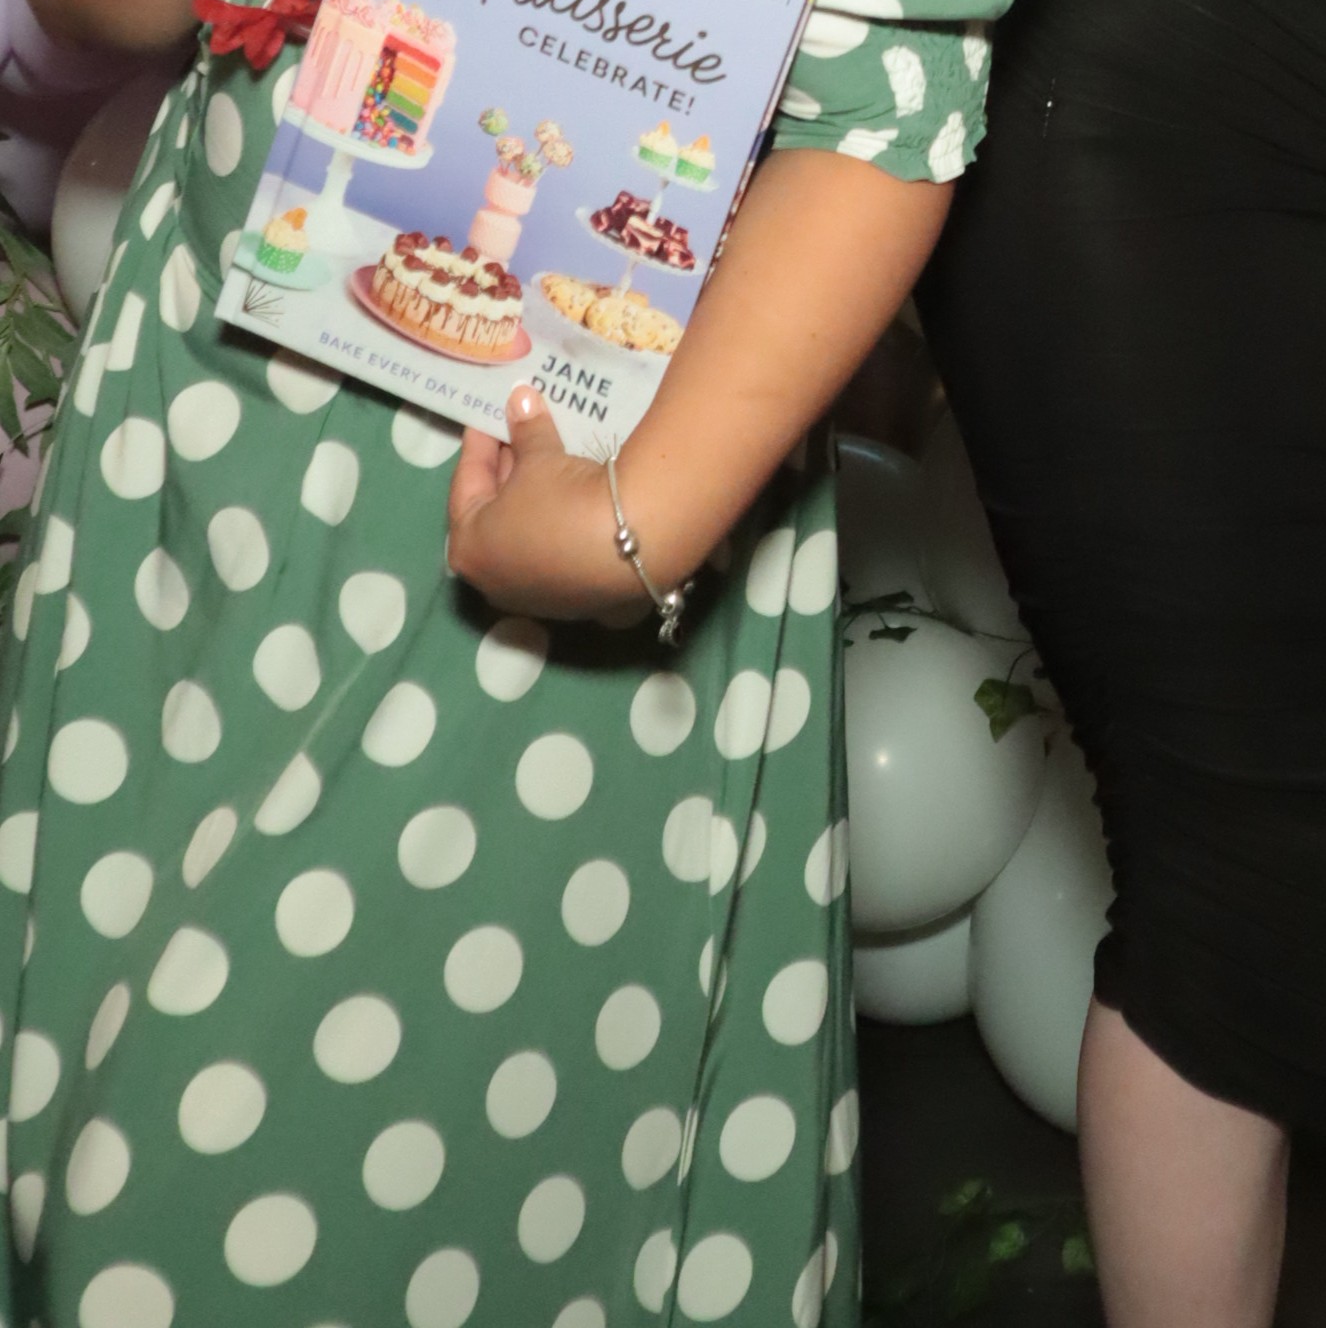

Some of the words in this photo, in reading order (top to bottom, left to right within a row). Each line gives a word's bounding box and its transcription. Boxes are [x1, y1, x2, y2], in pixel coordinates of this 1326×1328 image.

[518, 26, 695, 116] CELEBRATE!
[319, 331, 362, 360] BAKE
[367, 354, 421, 382] EVERY
[425, 377, 458, 399] DAY
[462, 393, 505, 421] SPEC
[531, 376, 609, 423] DUNN
[542, 355, 612, 397] JANE
